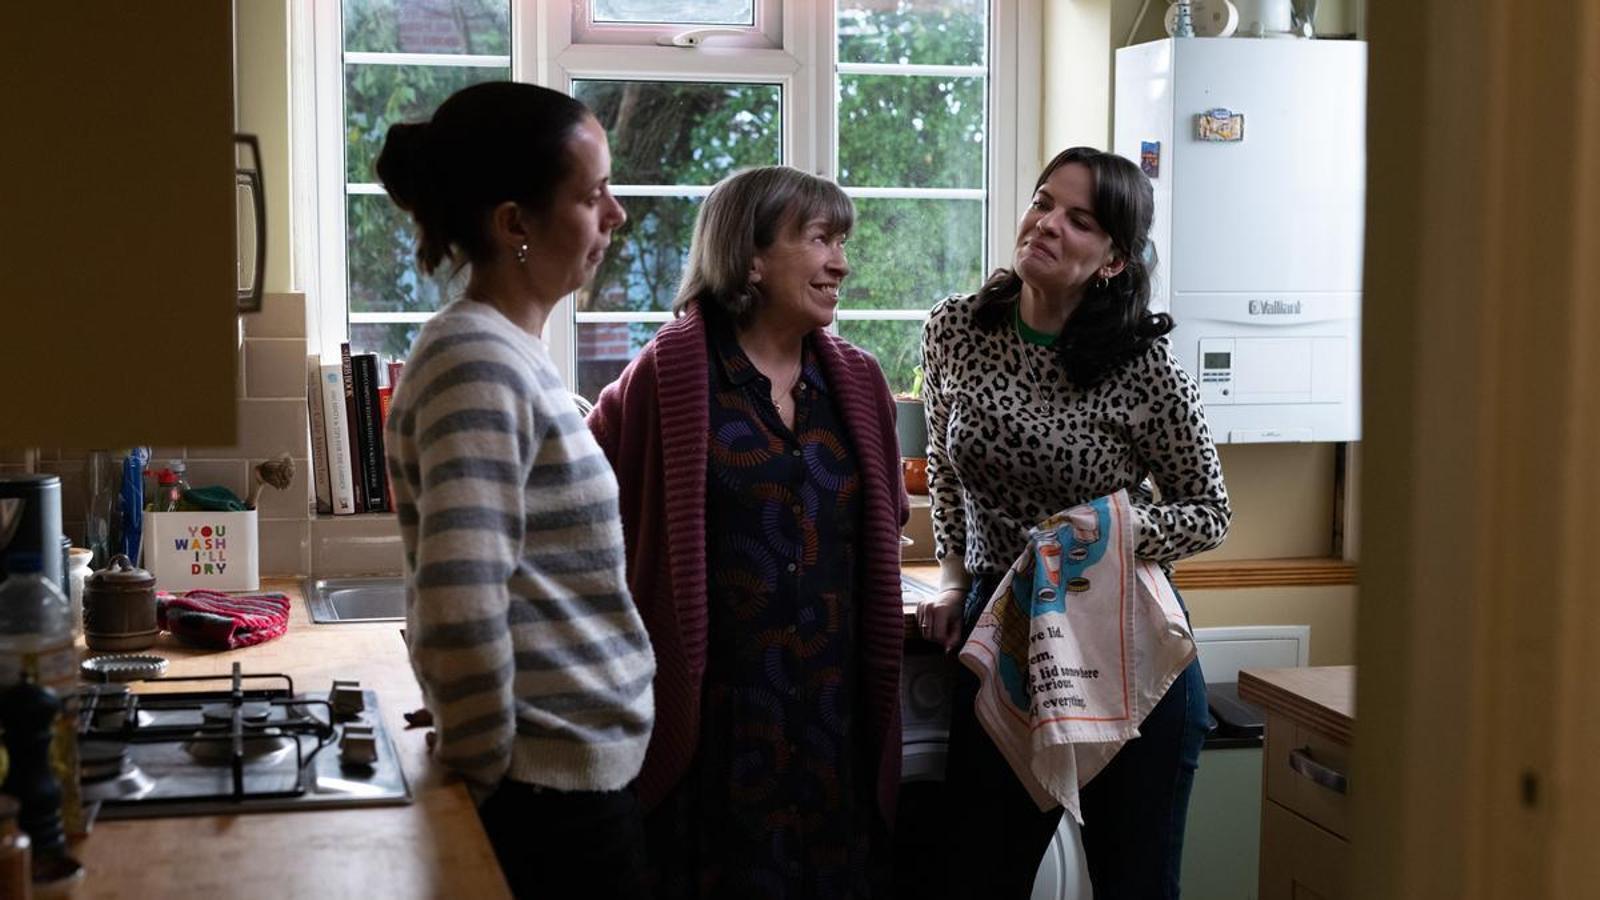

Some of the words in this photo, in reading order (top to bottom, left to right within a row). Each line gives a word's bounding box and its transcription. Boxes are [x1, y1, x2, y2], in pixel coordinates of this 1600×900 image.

[188, 526, 226, 537] YOU
[174, 539, 226, 550] WASH
[195, 551, 226, 562] I'LL
[192, 563, 226, 575] DRY
[1030, 631, 1045, 642] ve
[1030, 651, 1054, 665] em.
[1040, 665, 1059, 680] lid
[1031, 678, 1074, 694] terious.
